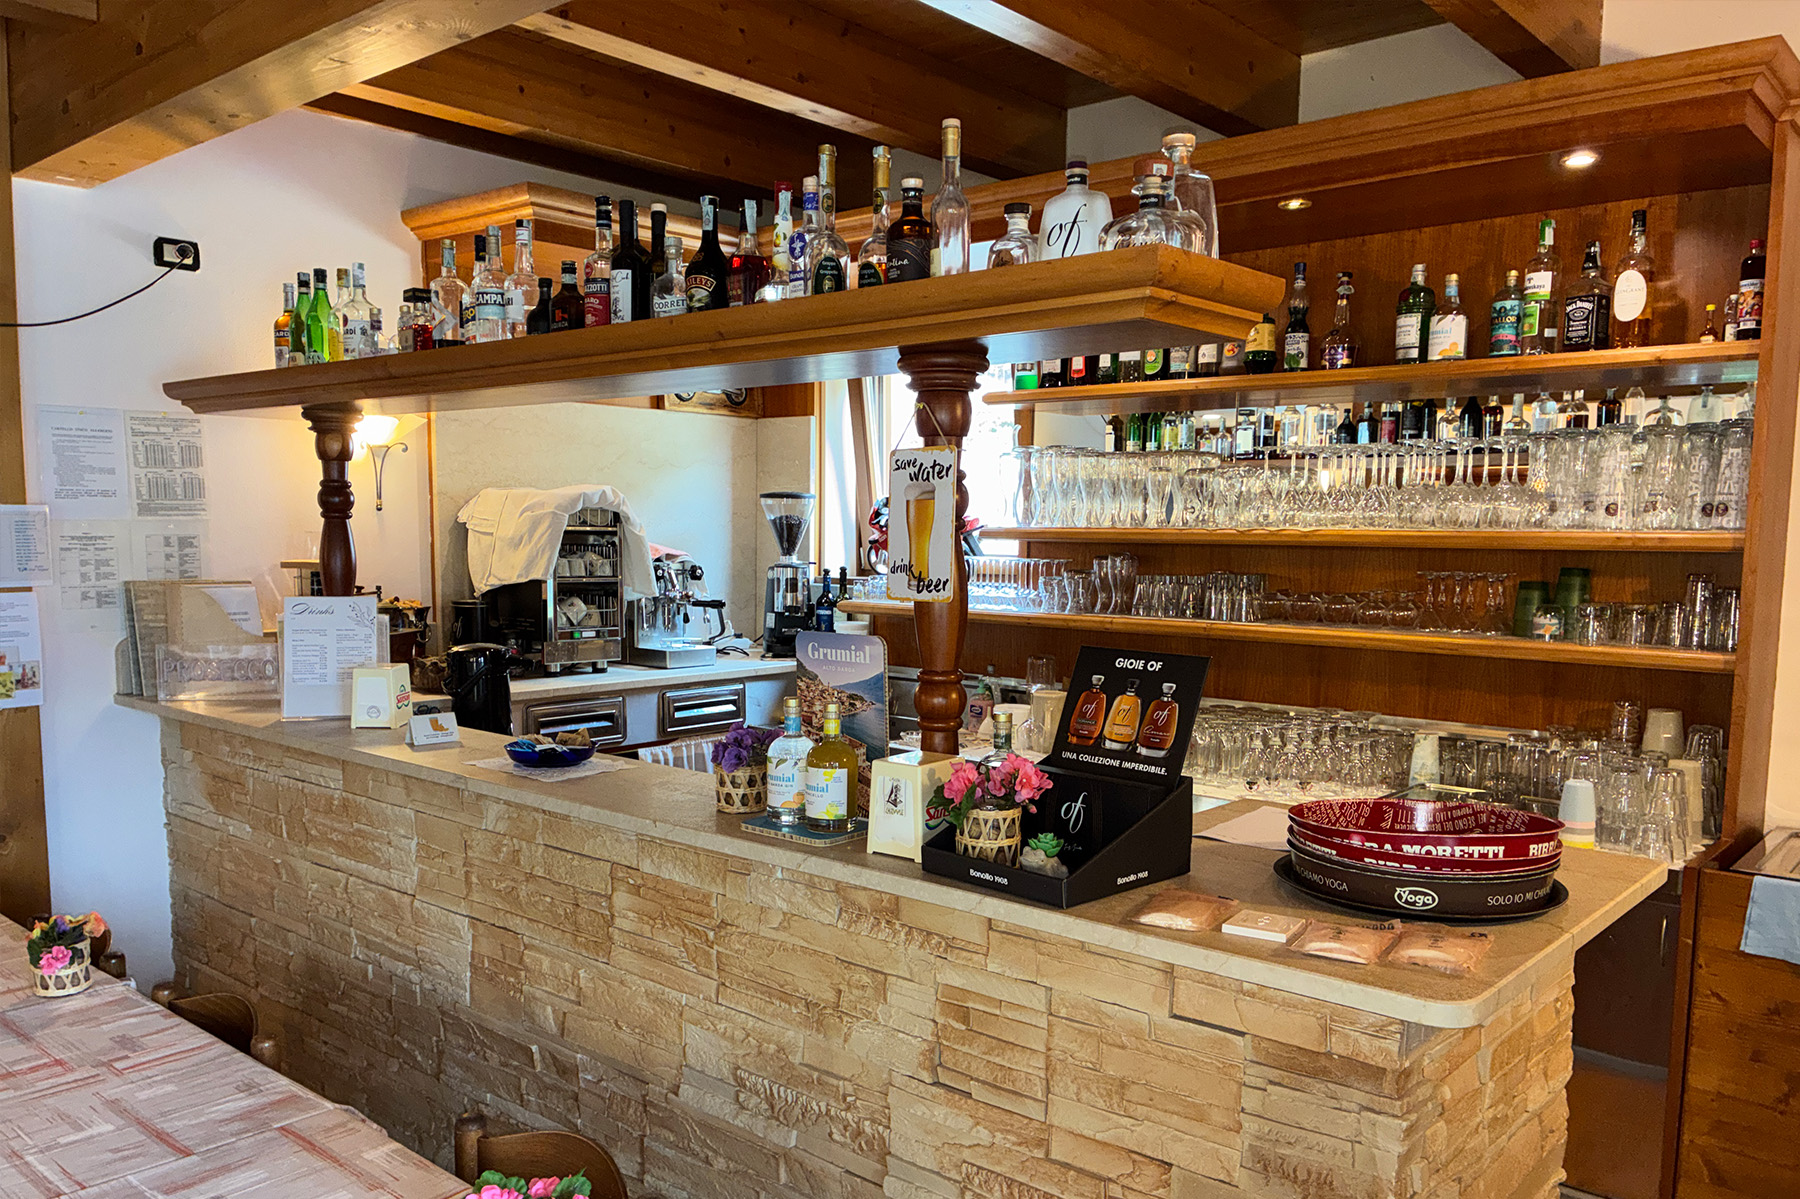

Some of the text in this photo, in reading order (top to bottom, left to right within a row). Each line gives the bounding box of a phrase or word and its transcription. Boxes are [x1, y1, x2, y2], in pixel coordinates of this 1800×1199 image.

[686, 276, 714, 288] AILEYS
[893, 457, 917, 472] save
[909, 459, 952, 483] water
[890, 558, 917, 579] drink
[916, 570, 949, 594] beer
[289, 602, 335, 616] Drinks
[807, 641, 870, 664] Grumial
[163, 658, 277, 682] PROSECCO
[1115, 658, 1163, 672] GIOIE OF
[1062, 751, 1168, 776] UNA COLLEZIONE IMPERDIBILE.
[1061, 792, 1088, 834] of
[1324, 876, 1349, 892] YOGA
[1400, 889, 1434, 907] Yoga
[1487, 895, 1513, 906] SOLO
[1513, 894, 1524, 904] IO
